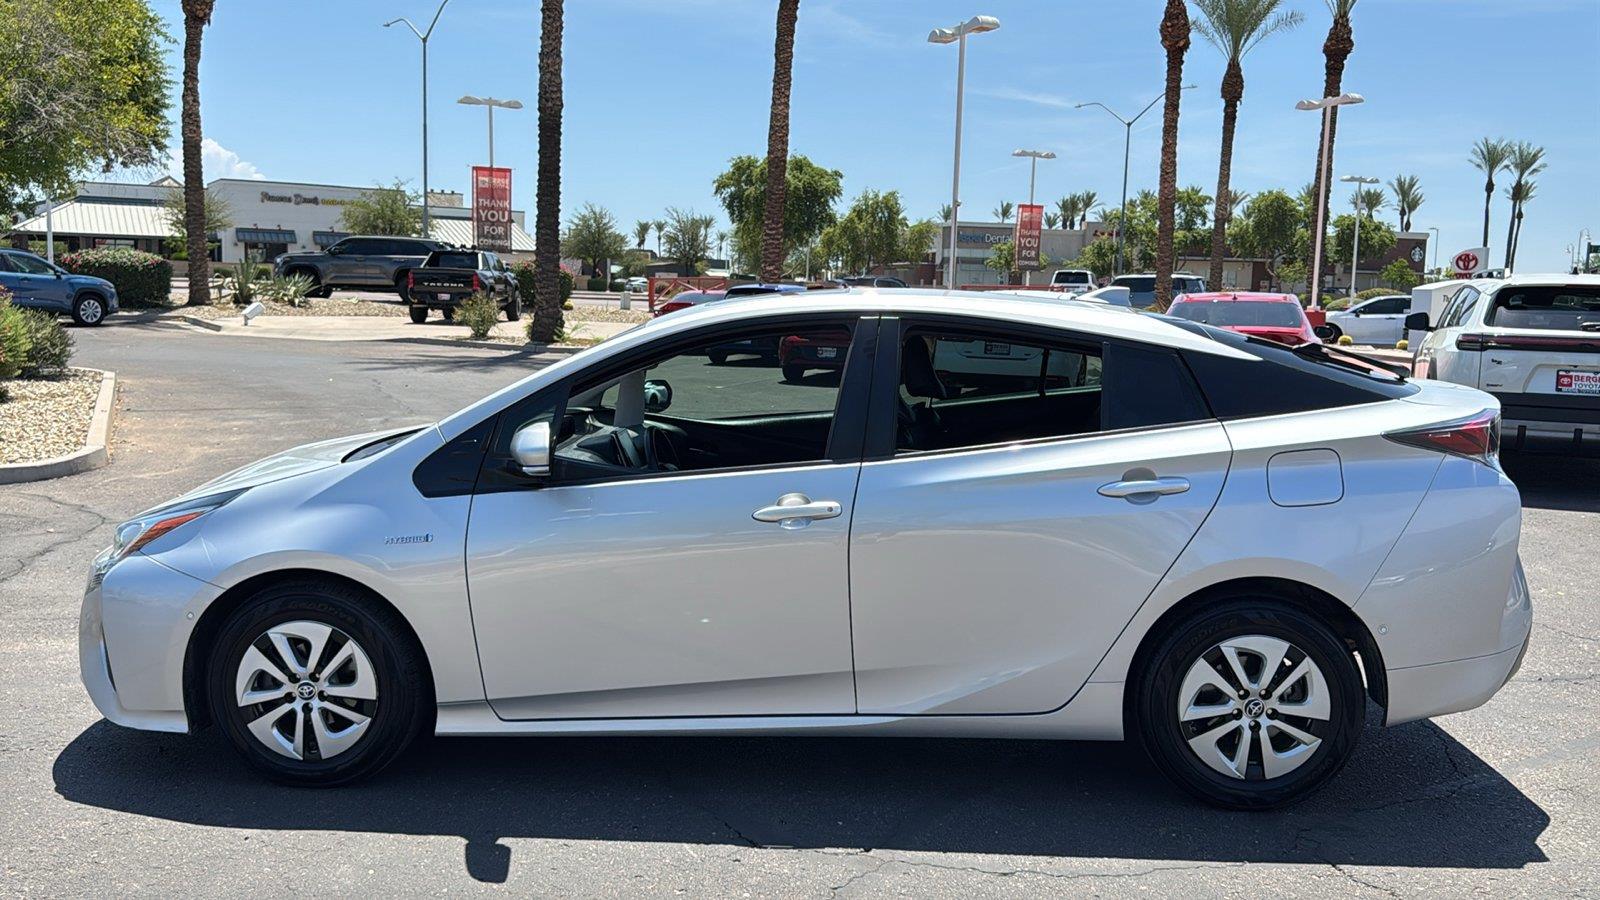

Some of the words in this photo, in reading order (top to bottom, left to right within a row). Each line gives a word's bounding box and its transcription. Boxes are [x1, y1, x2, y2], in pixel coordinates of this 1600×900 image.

[479, 199, 509, 208] THANK
[480, 210, 509, 222] YOU
[484, 226, 504, 235] FOR
[985, 233, 1012, 243] Dental
[1020, 238, 1039, 247] YOU
